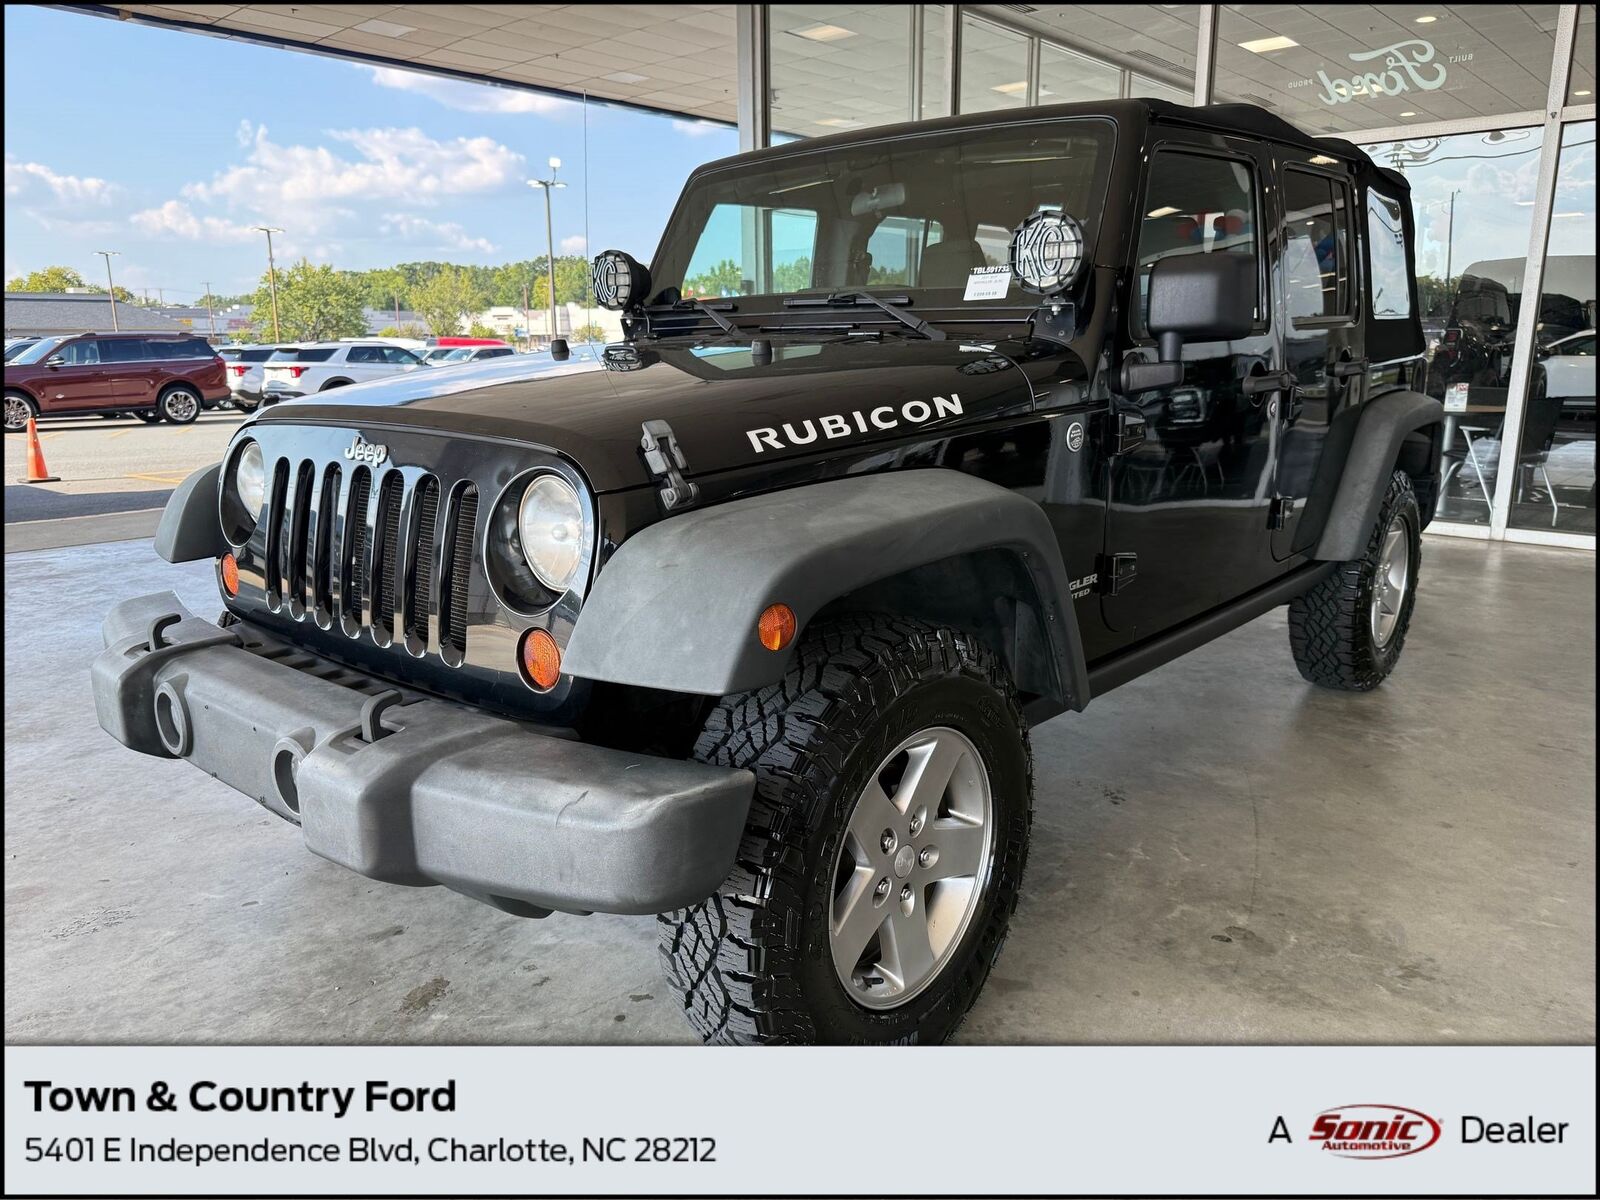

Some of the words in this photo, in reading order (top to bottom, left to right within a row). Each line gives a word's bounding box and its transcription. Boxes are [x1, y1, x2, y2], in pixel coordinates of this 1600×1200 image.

[1016, 222, 1064, 281] KC
[591, 258, 616, 302] KC
[746, 393, 964, 453] RUBICON
[344, 436, 387, 467] Jeep
[1069, 573, 1098, 591] GLER
